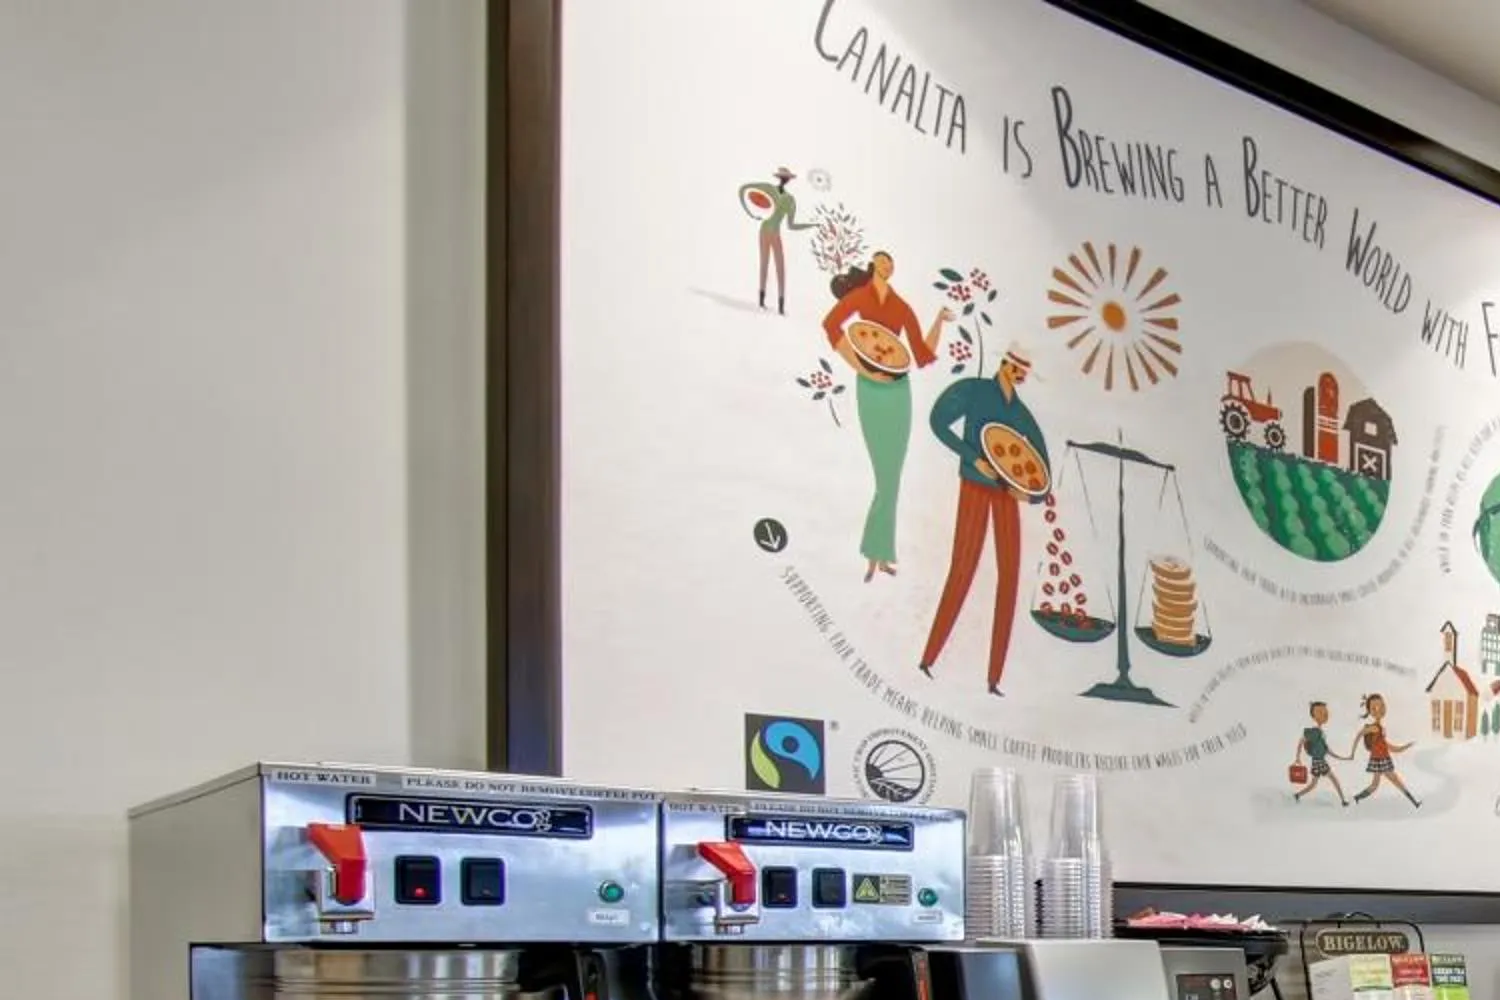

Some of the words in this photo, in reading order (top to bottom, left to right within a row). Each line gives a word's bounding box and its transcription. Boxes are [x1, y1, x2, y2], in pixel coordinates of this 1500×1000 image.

[814, 0, 968, 154] CANALTA
[1002, 115, 1034, 180] IS
[1051, 85, 1186, 203] BREWING
[1204, 153, 1224, 209] A
[1243, 135, 1328, 250] BETTER
[1344, 207, 1412, 315] WORLD
[1421, 299, 1469, 372] WITH
[850, 657, 884, 694] TRADE
[882, 686, 919, 718] MEANS
[967, 725, 998, 750] SMALL
[276, 771, 310, 782] HOT
[317, 773, 372, 785] WATER
[406, 777, 459, 789] PLEASE
[465, 780, 485, 790] DO
[489, 783, 515, 793] NOT
[400, 803, 540, 829] NEWCO
[765, 820, 872, 842] NEWCO
[1323, 935, 1402, 951] BIGELOW
